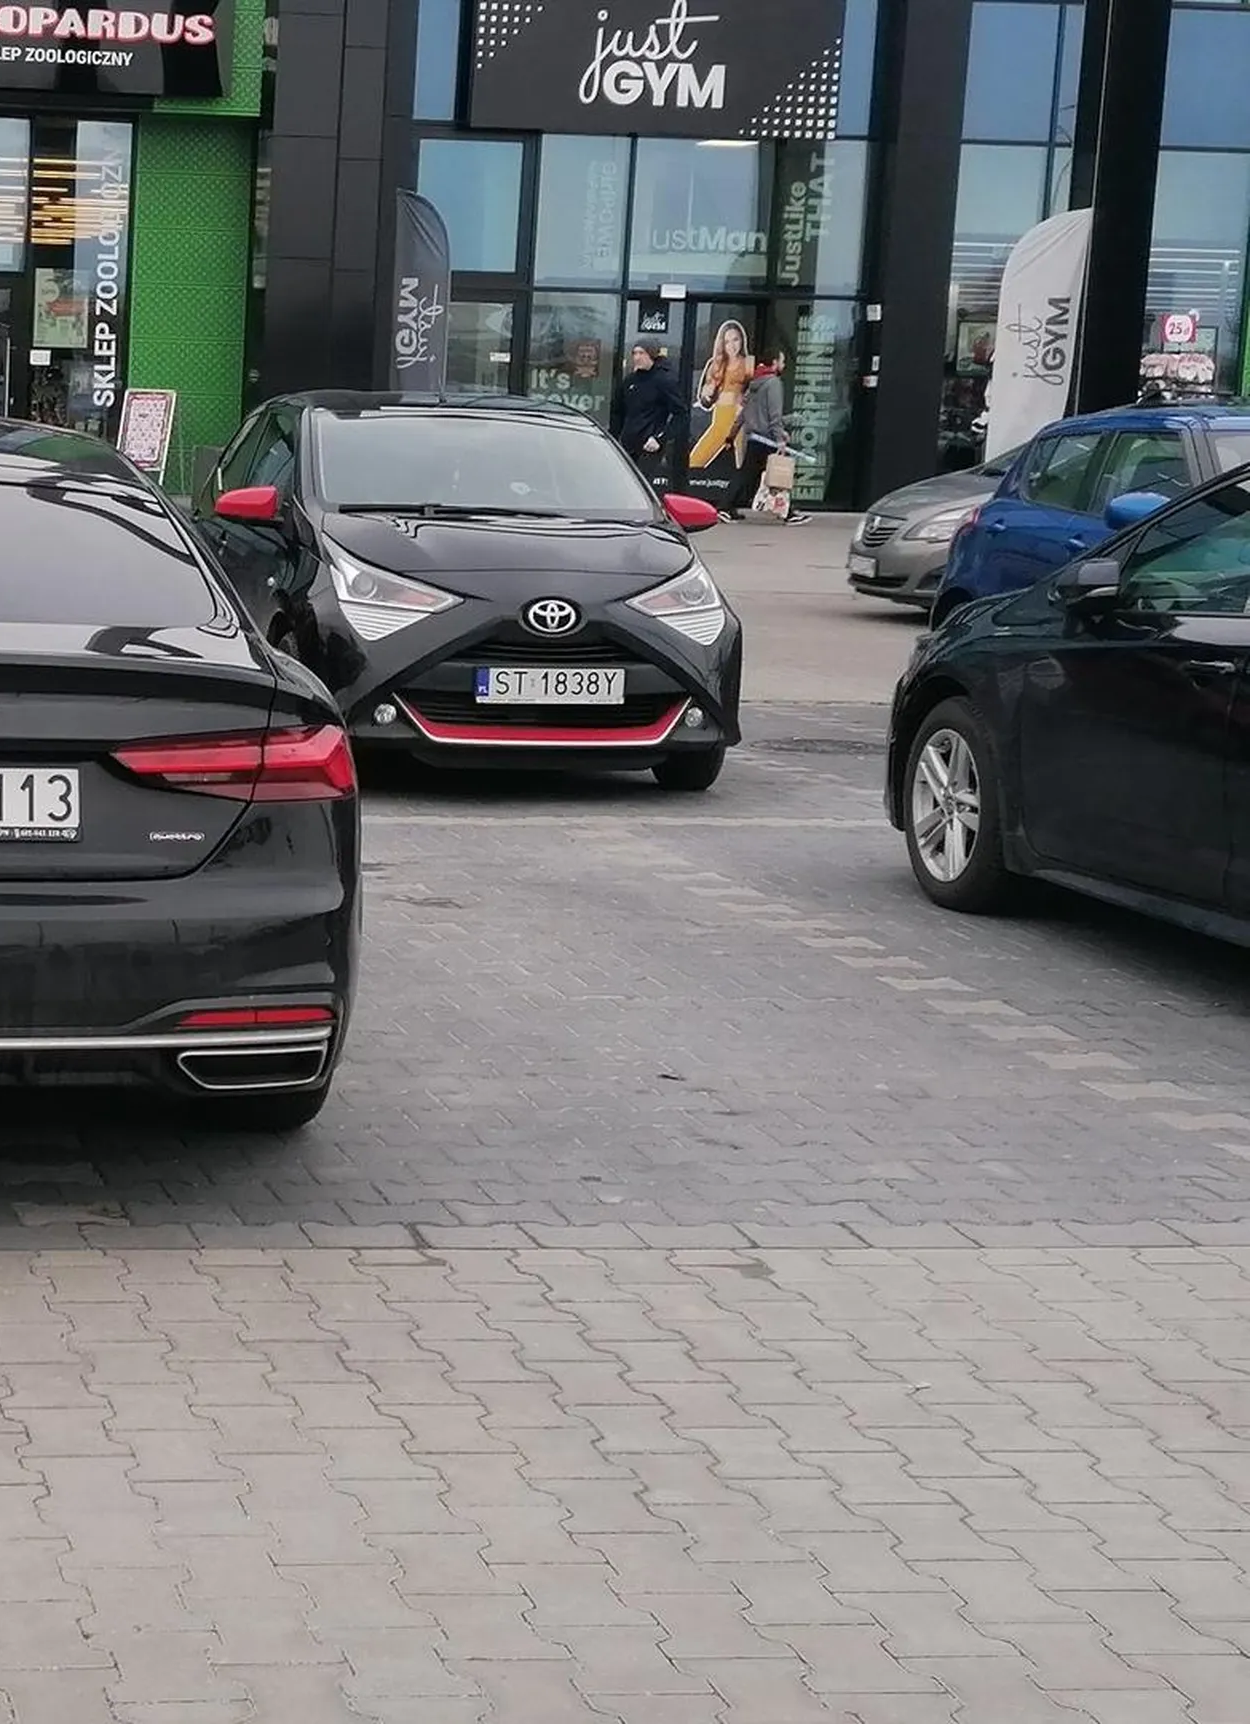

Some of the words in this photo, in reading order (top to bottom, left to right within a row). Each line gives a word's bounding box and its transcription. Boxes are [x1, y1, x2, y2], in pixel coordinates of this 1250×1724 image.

[25, 47, 133, 67] ZOOLOGICZNY
[578, 0, 720, 104] just
[602, 60, 726, 109] GYM
[95, 136, 126, 316] ZOOLOCZN
[781, 181, 807, 287] JustLike
[805, 152, 835, 242] THAT
[647, 225, 768, 252] ustMan
[93, 322, 117, 408] SKLEP
[1006, 304, 1064, 386] just
[1041, 297, 1071, 371] GYM
[531, 369, 570, 389] It's
[495, 671, 528, 695] ST
[541, 671, 617, 695] 1838Y
